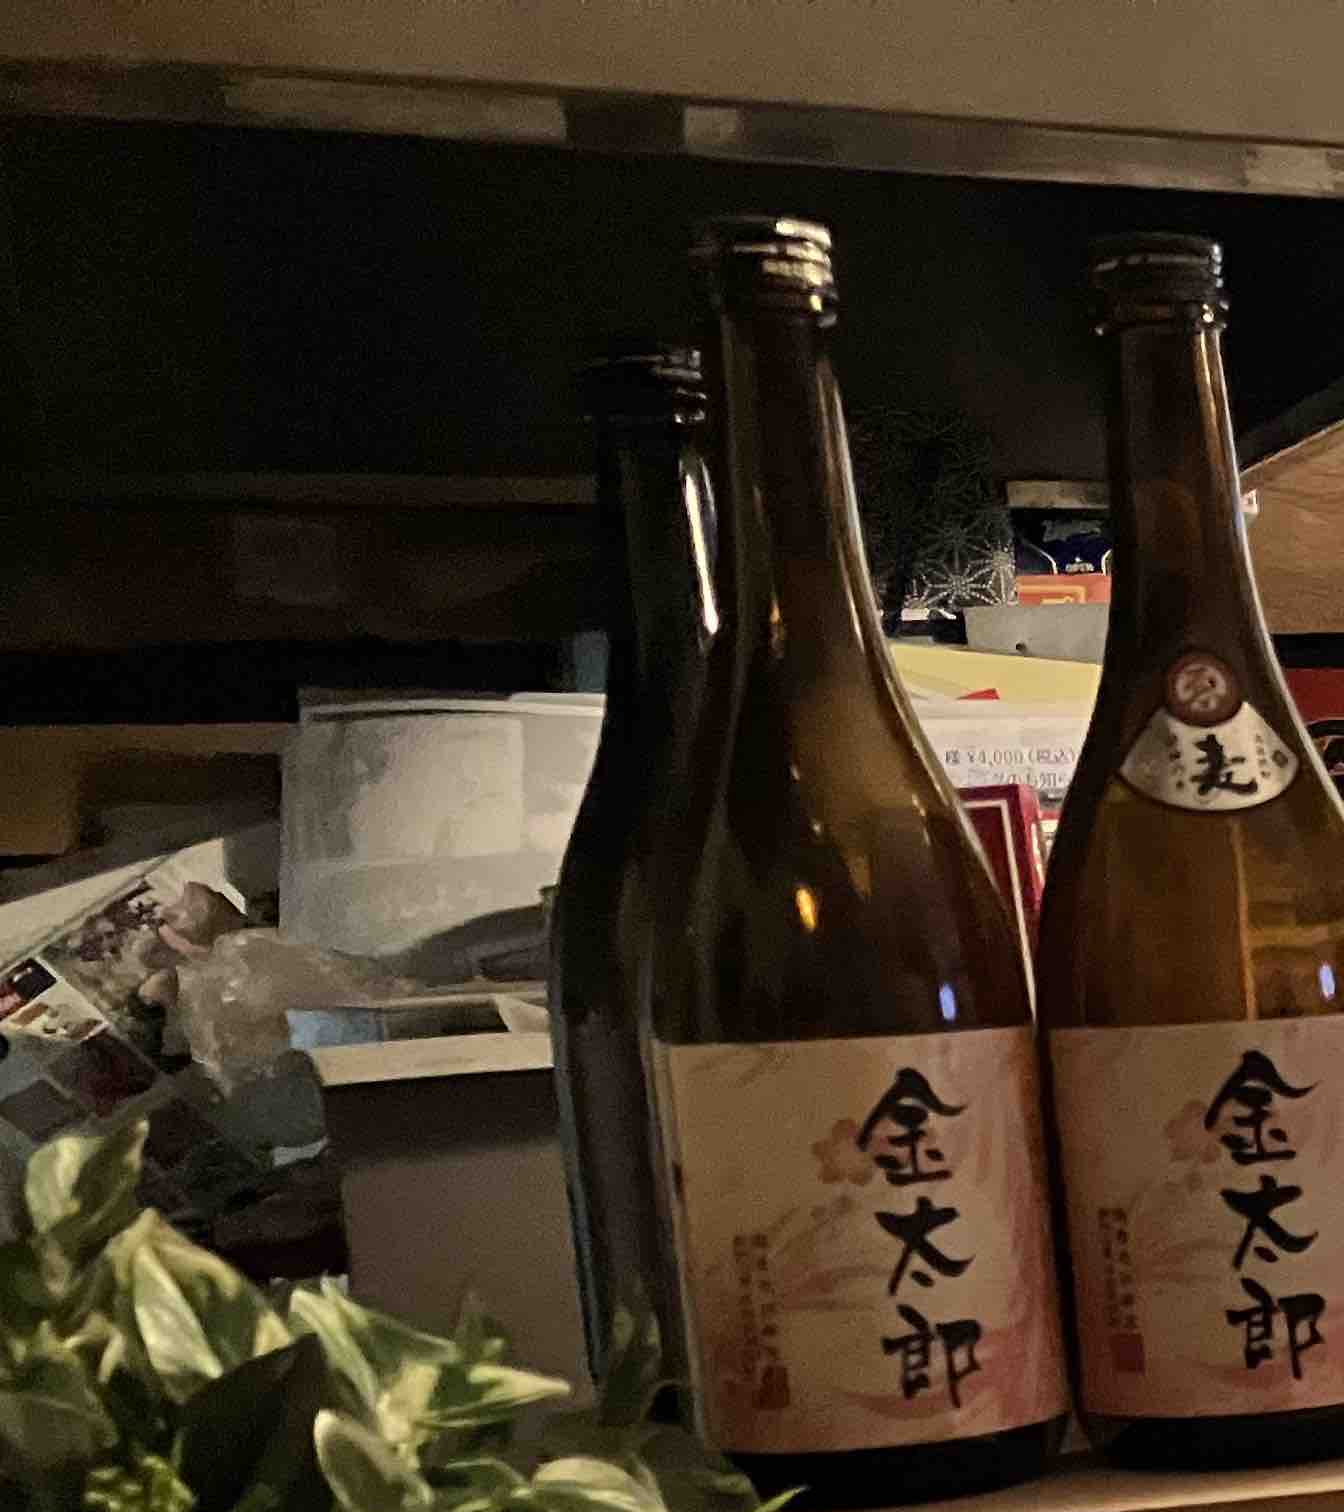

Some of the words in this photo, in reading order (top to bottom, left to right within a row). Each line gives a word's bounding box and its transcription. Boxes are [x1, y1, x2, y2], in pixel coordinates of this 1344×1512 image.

[857, 1067, 983, 1408] 金太郎
[1203, 1050, 1326, 1380] 金太郎
